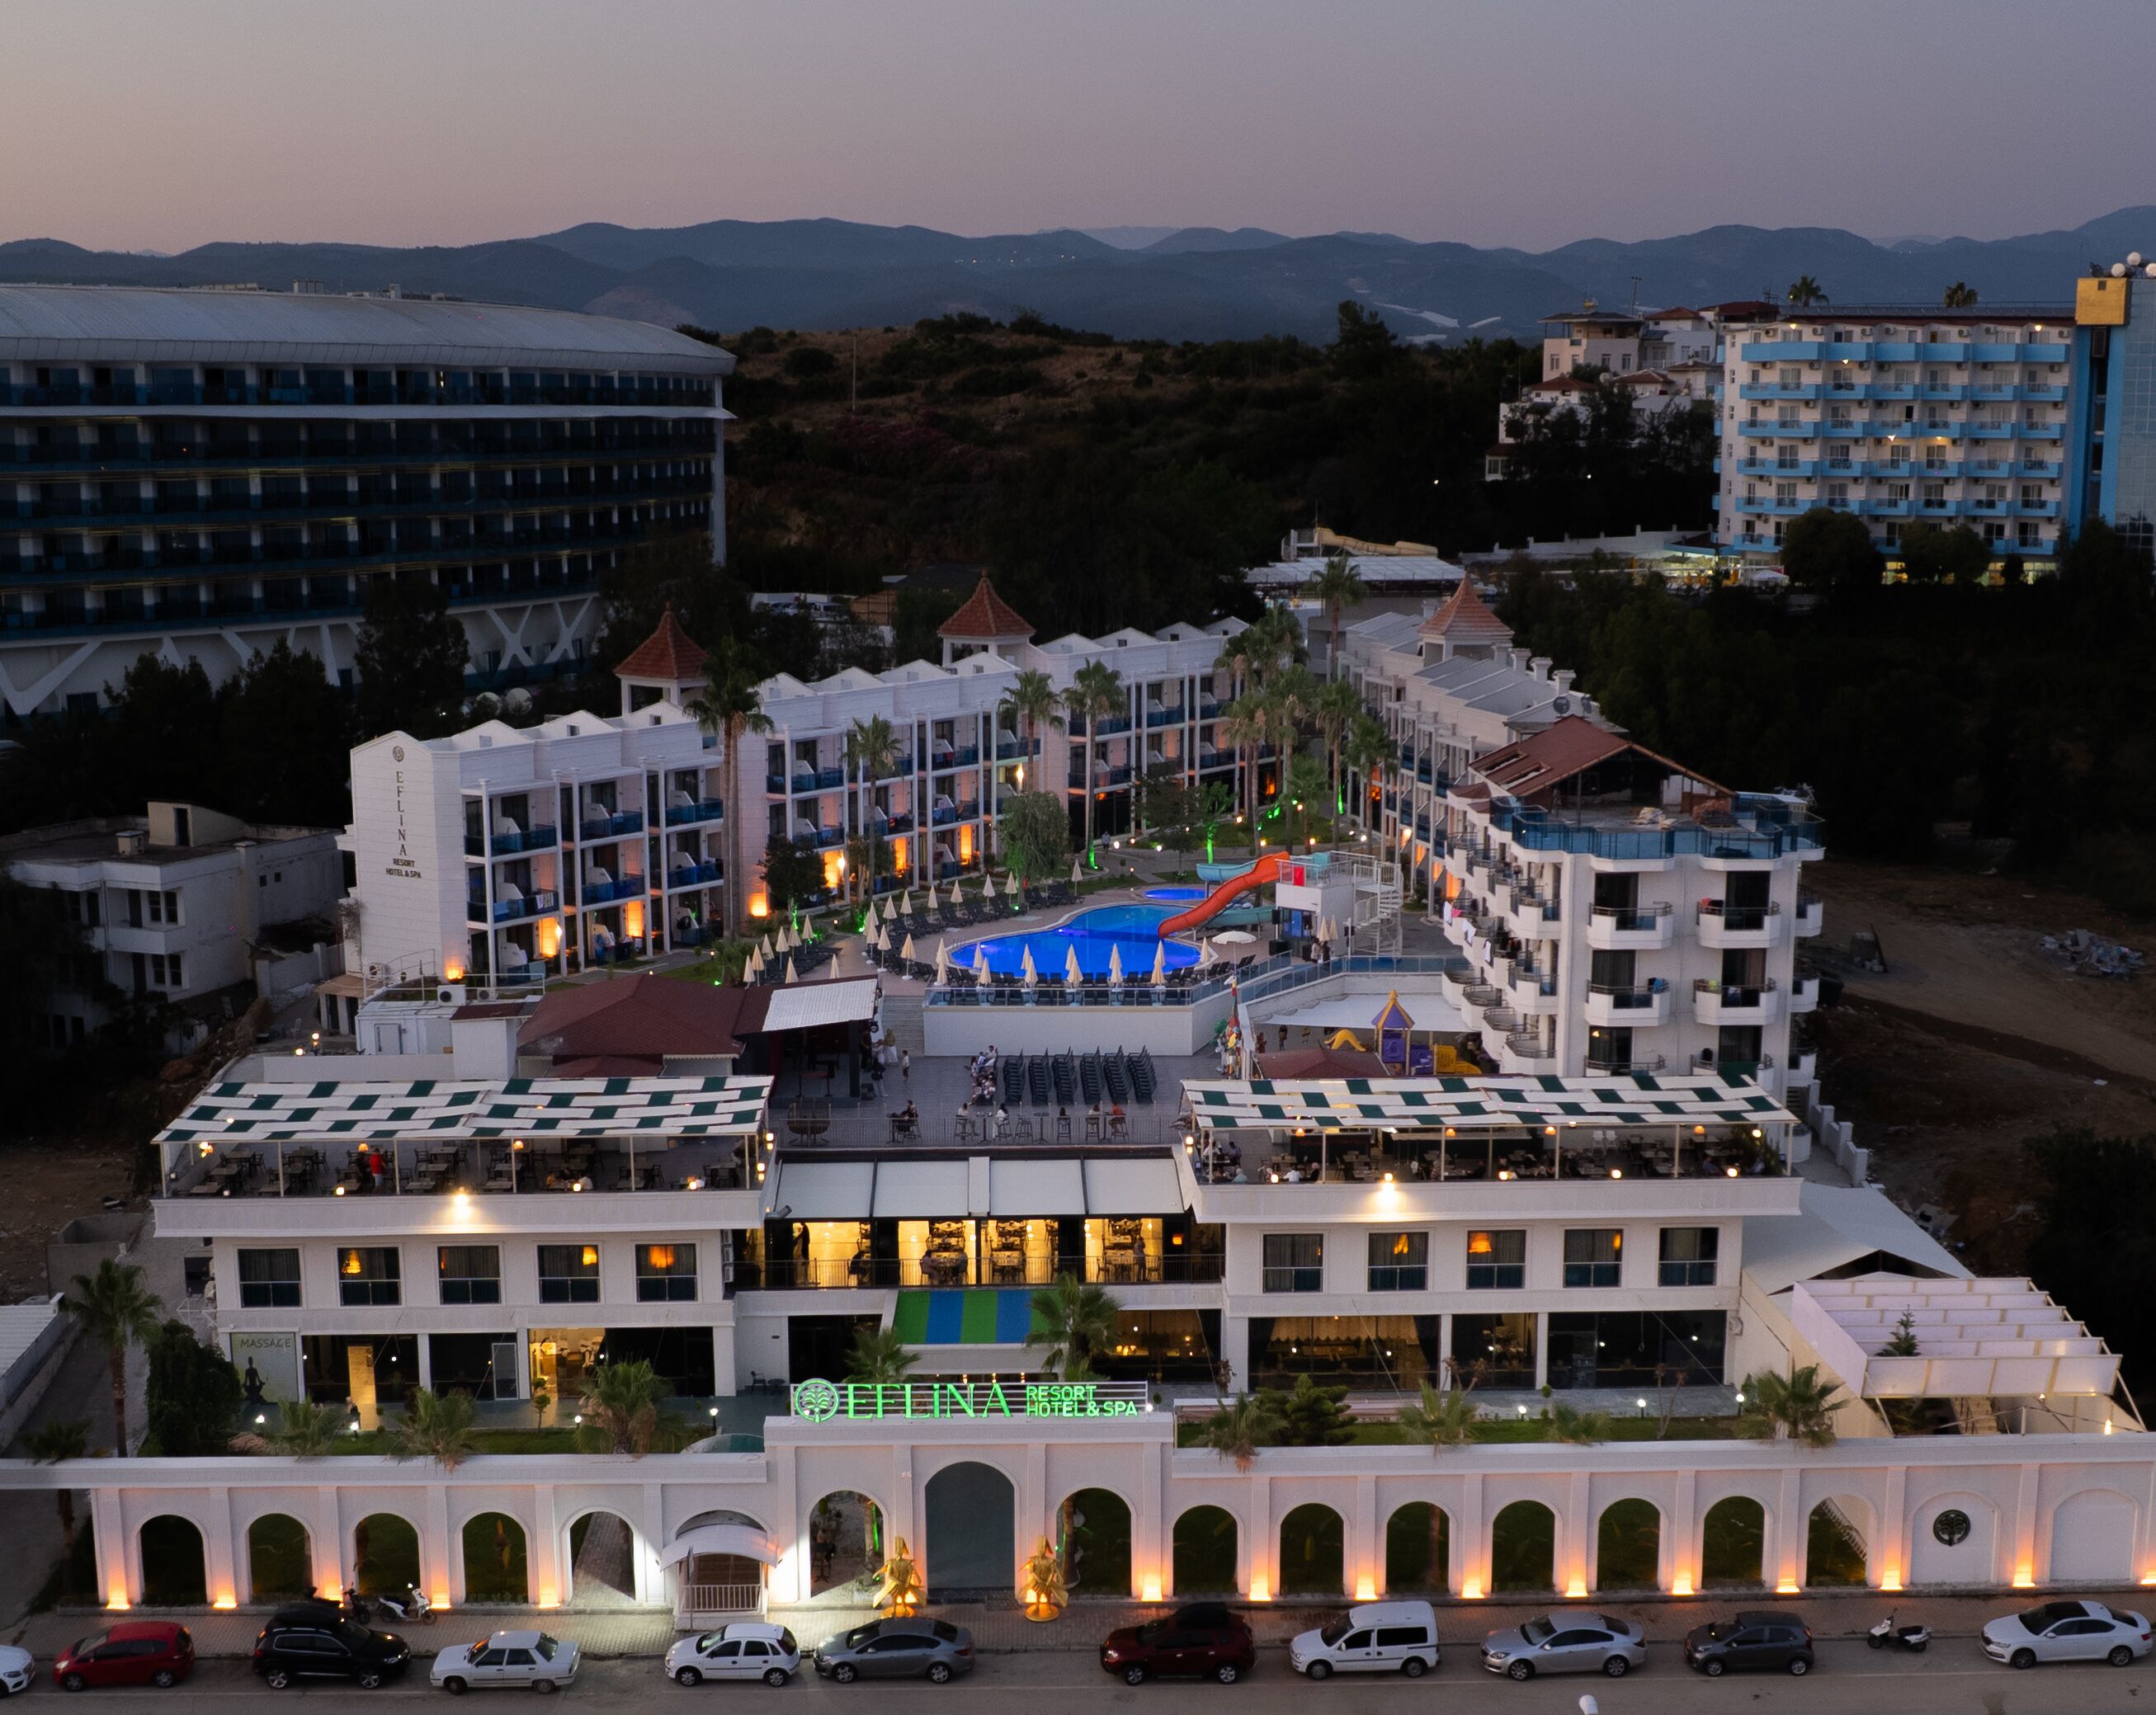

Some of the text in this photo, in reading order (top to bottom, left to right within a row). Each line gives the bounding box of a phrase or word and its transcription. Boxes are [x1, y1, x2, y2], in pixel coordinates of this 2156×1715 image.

[393, 858, 415, 867] RESORT
[385, 868, 403, 877] HOTEL
[410, 870, 422, 879] SPA
[240, 1338, 290, 1348] MASSAGE
[1026, 1385, 1097, 1402] RESORT
[1103, 1401, 1138, 1417] SPA
